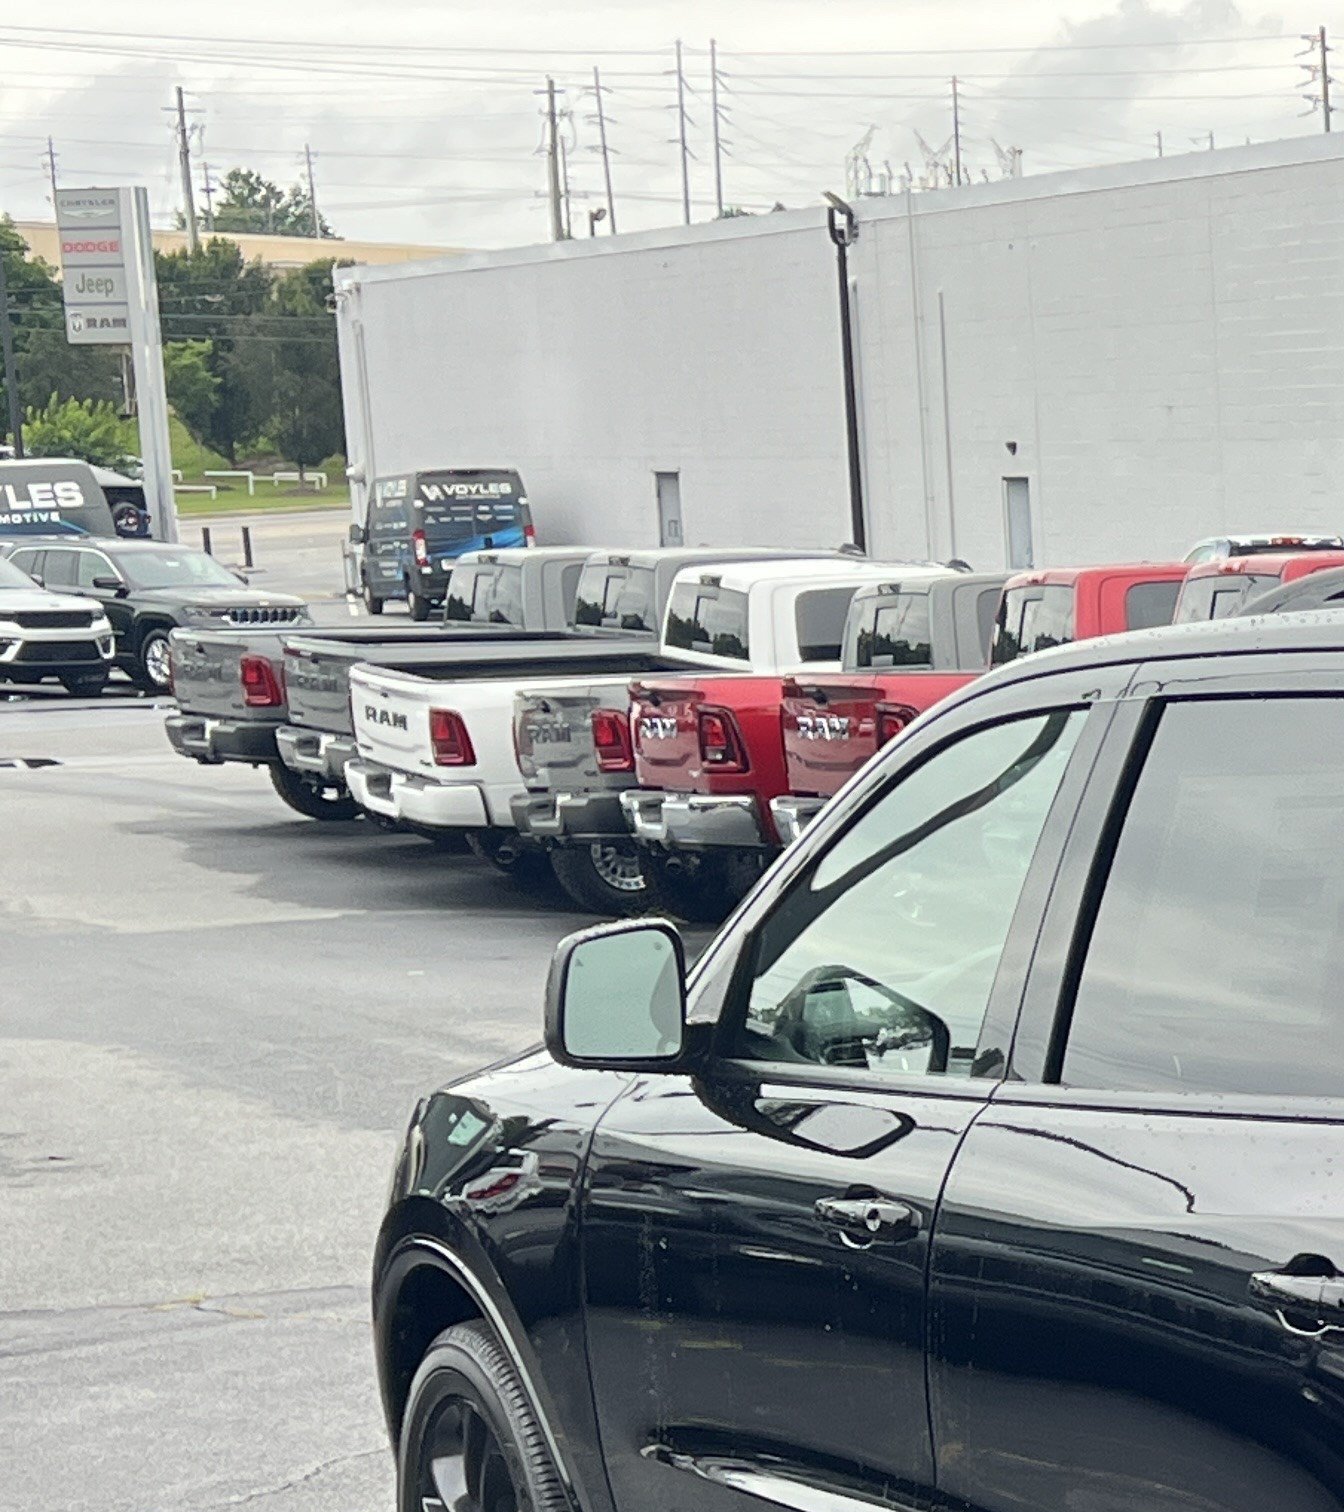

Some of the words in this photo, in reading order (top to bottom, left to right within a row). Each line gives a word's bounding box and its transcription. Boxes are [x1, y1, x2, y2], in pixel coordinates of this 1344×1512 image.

[62, 240, 120, 253] DODGE
[76, 273, 114, 297] Jeep
[86, 317, 127, 329] RAM
[0, 481, 84, 510] LES
[442, 482, 512, 496] VOYLES
[365, 704, 408, 731] RAM
